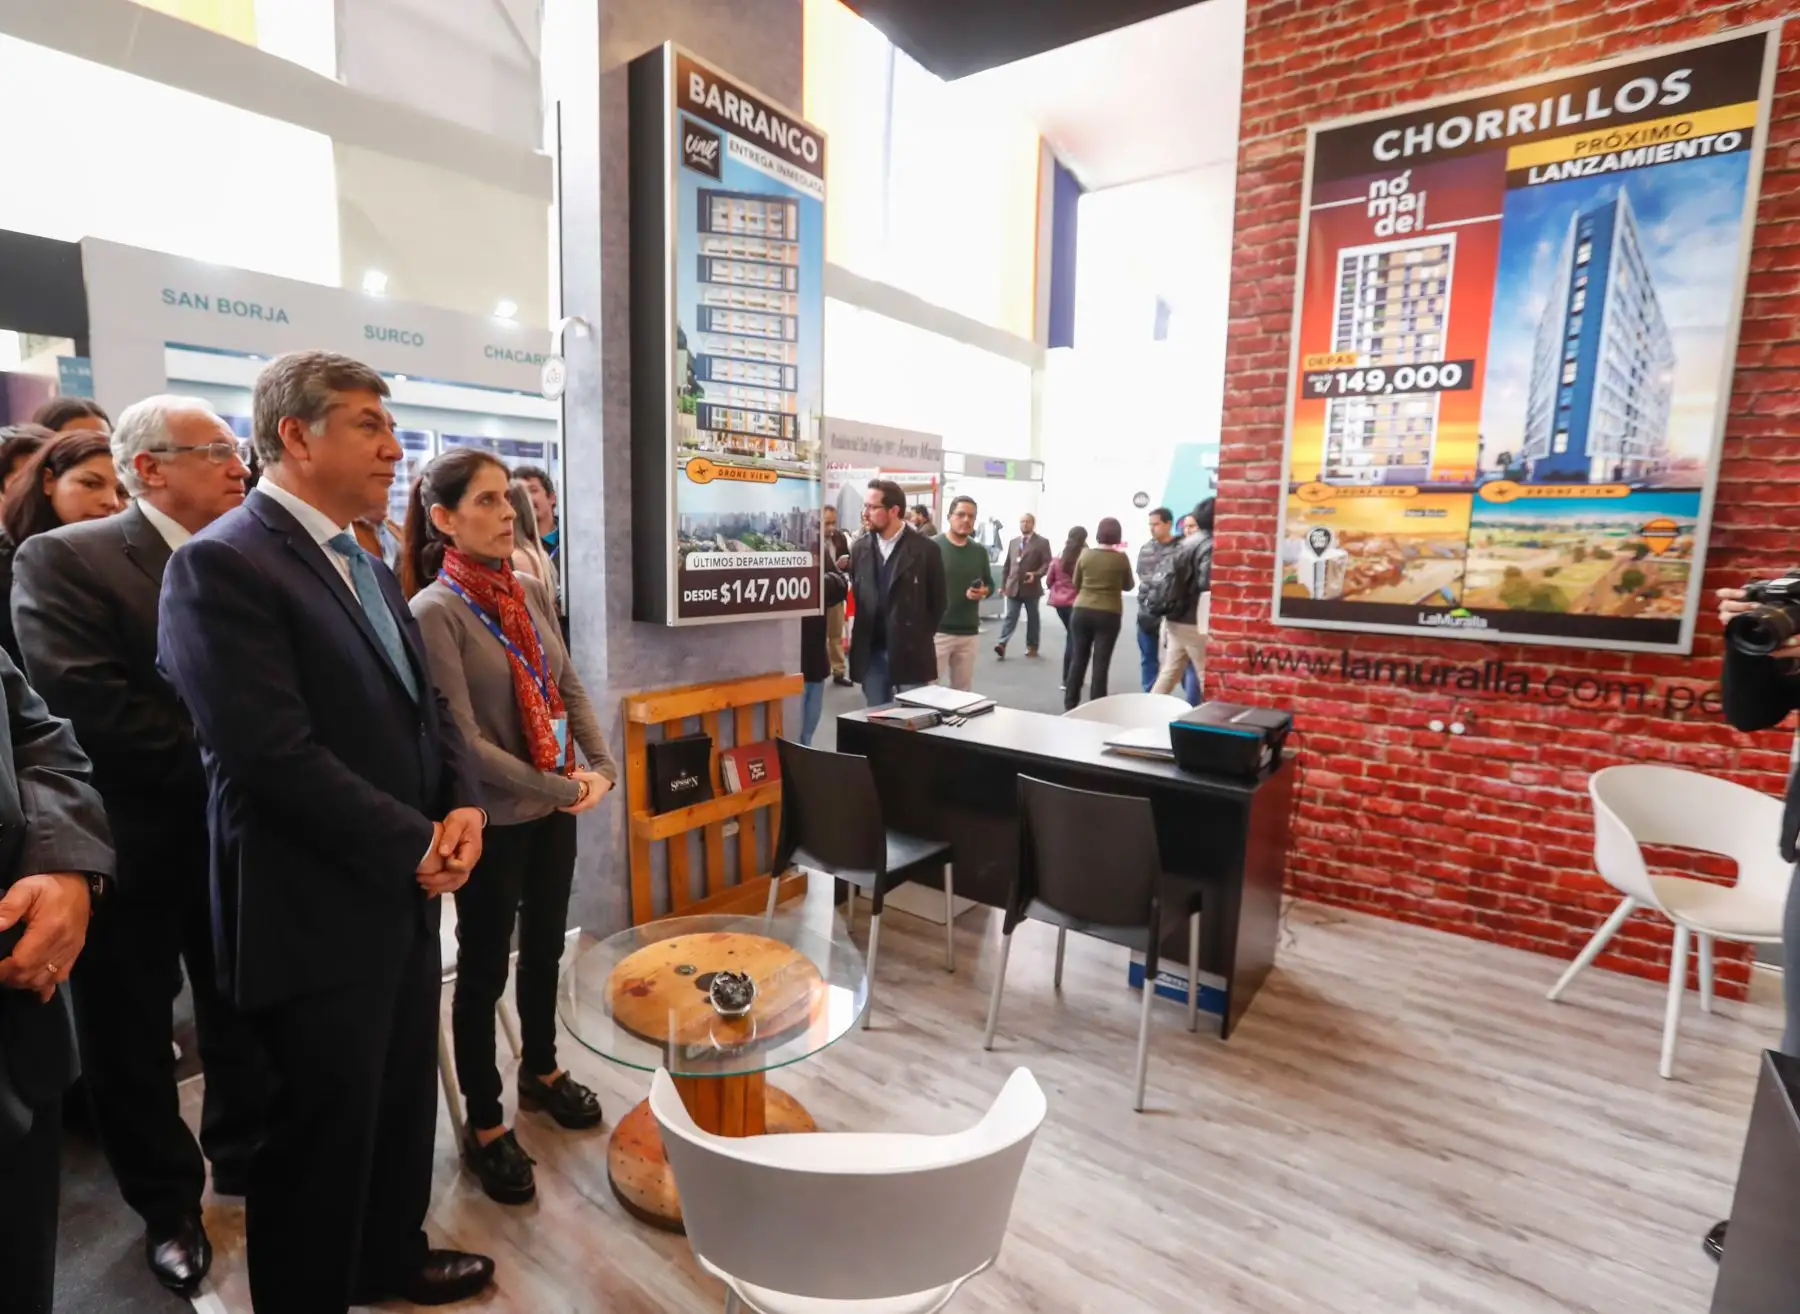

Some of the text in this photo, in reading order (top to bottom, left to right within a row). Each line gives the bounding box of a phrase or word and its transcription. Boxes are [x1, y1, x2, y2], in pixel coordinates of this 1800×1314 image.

[689, 71, 818, 163] BARRANCO
[1373, 68, 1693, 161] CHORRILLOS
[1573, 119, 1693, 154] PRÓXIMO
[729, 139, 775, 170] ENTREGA
[1528, 132, 1742, 184] LANZAMIENTO
[161, 288, 290, 325] SAN BORJA
[364, 325, 425, 347] SURCO
[1308, 354, 1354, 367] DEPAS
[1335, 363, 1463, 394] 149,000
[693, 555, 807, 569] ÚLTIMOS DEPARTAMENTOS
[684, 576, 811, 605] DESDE $147,000
